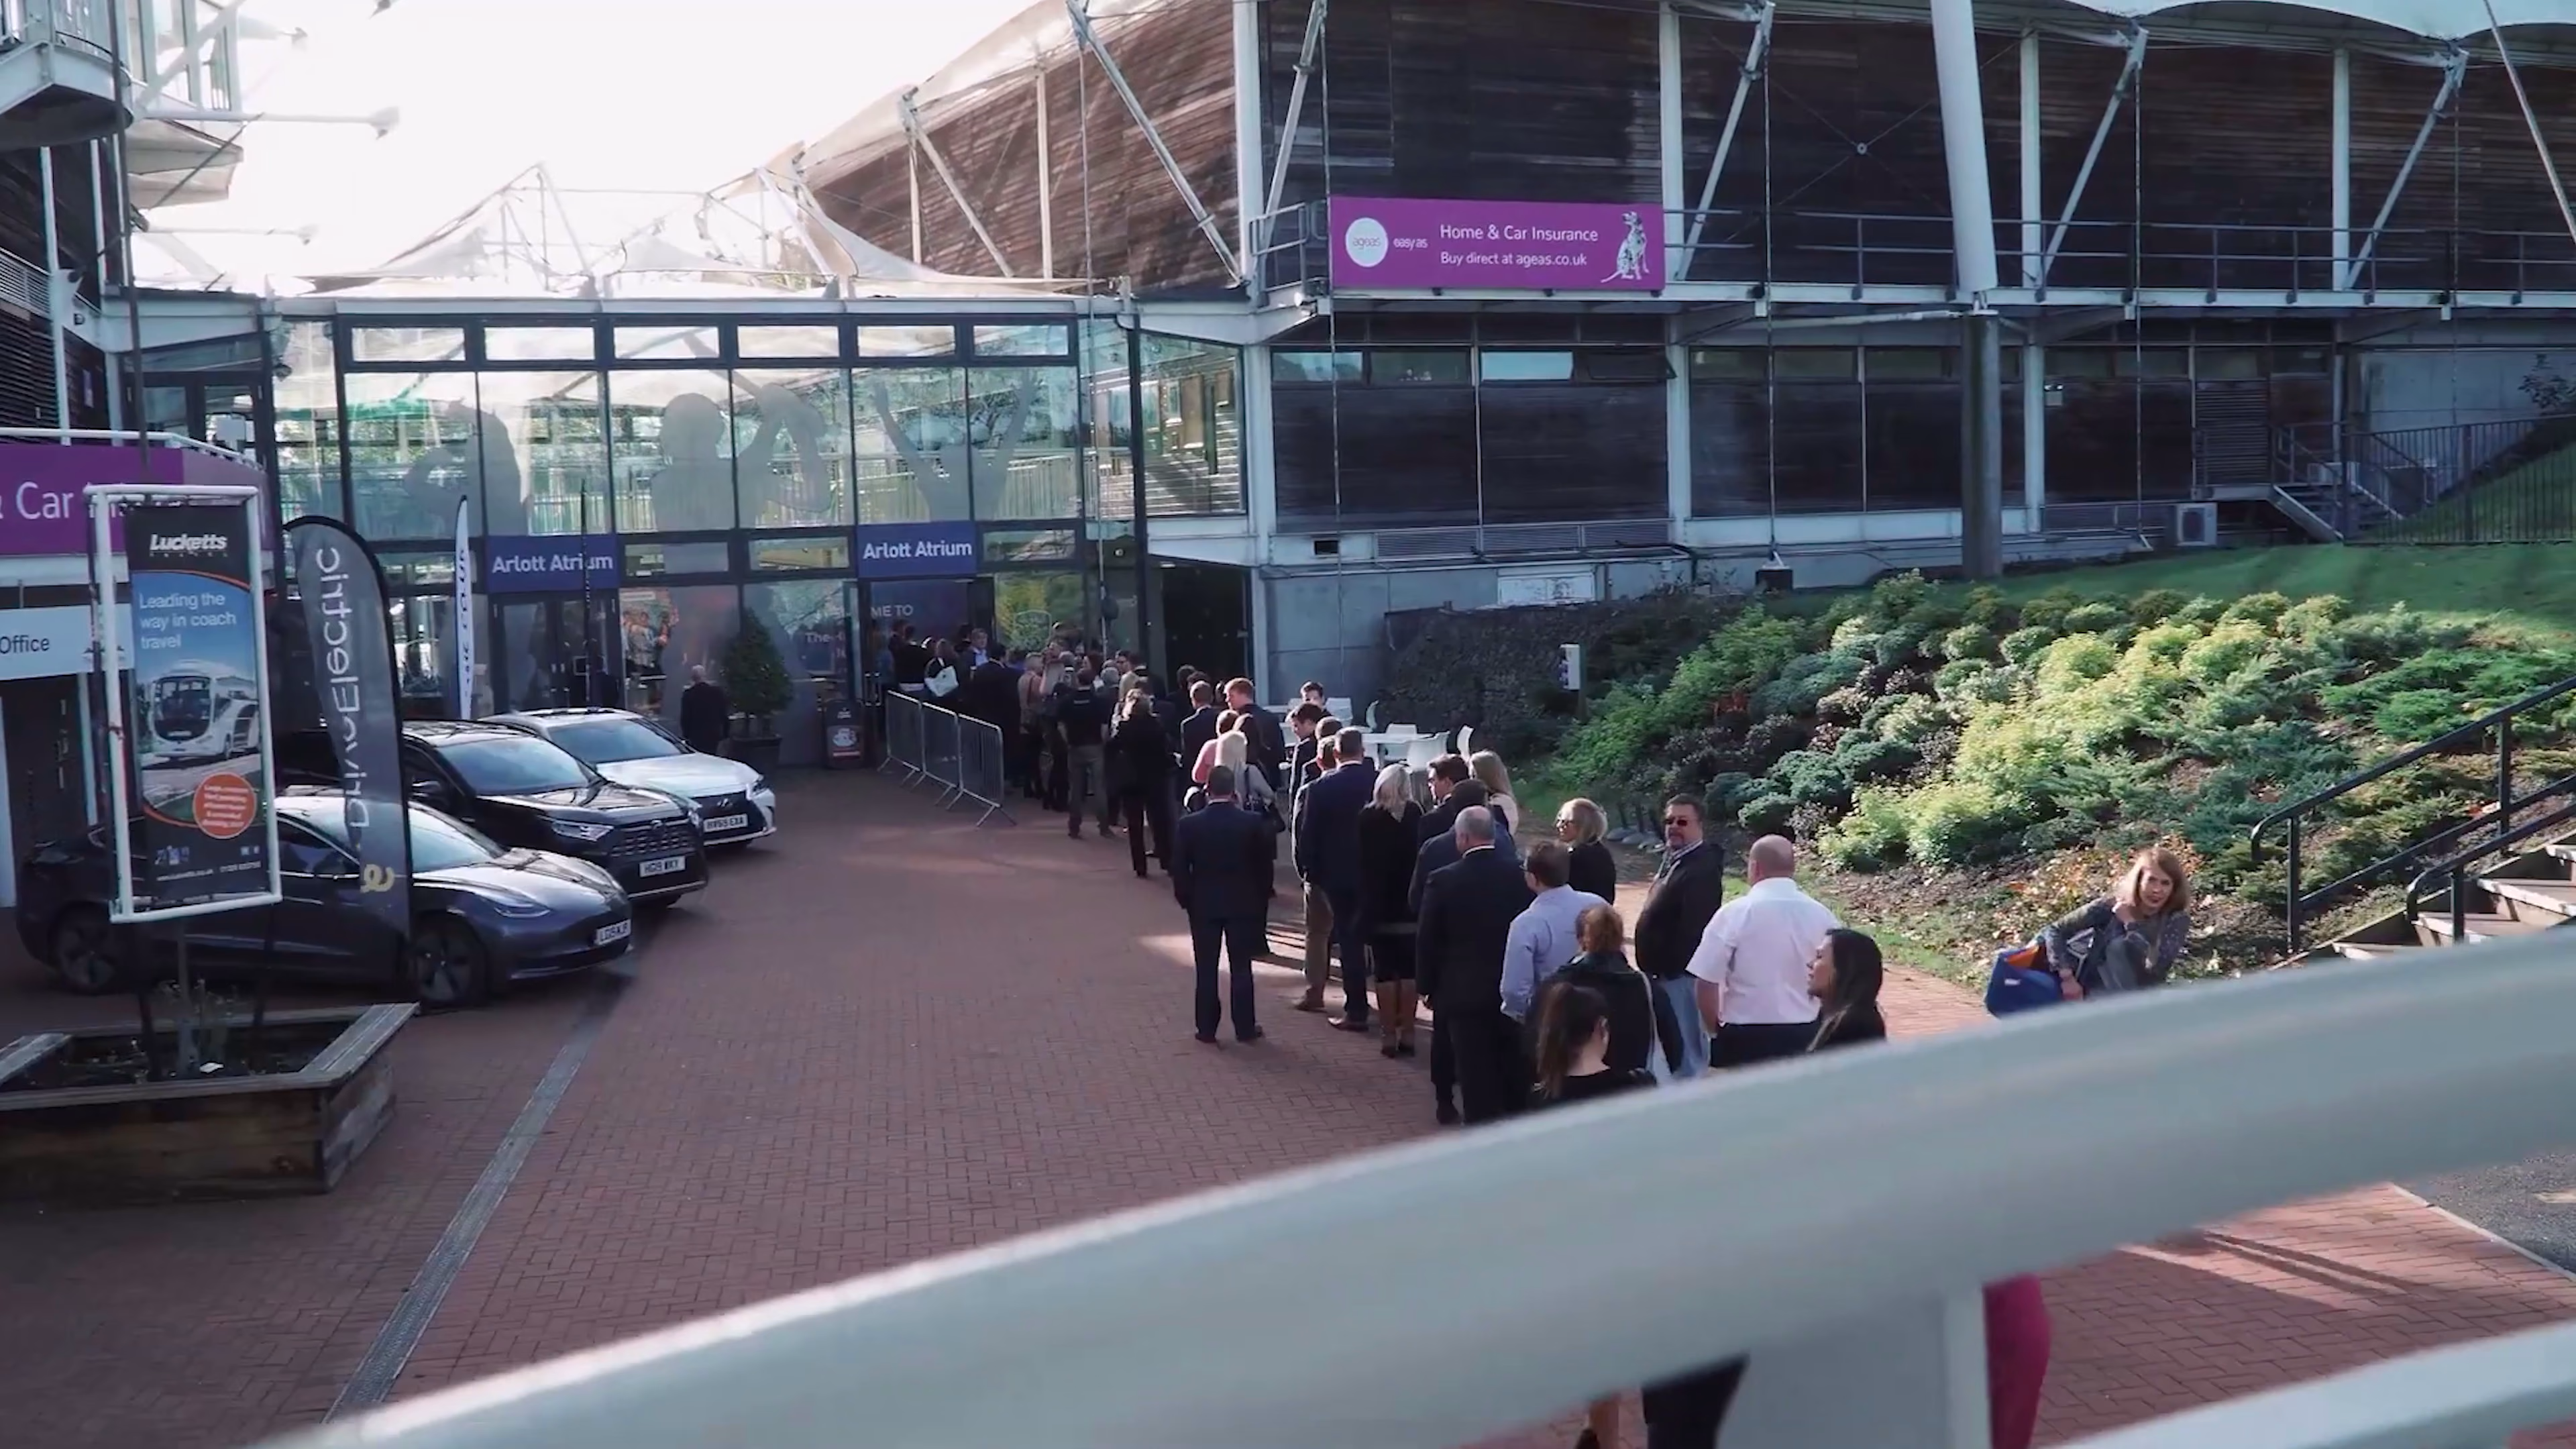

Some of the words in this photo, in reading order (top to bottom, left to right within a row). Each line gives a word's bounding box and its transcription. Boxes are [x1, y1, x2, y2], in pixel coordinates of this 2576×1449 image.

[1440, 224, 1484, 240] Home
[1487, 223, 1500, 240] &
[1504, 225, 1527, 240] Car
[1532, 226, 1599, 242] Insurance
[1352, 237, 1381, 250] ageas
[1440, 251, 1464, 266] Buy
[1466, 252, 1499, 265] direct
[1501, 253, 1513, 265] at
[1515, 253, 1588, 268] ageas.co.uk
[16, 481, 74, 520] Car
[149, 533, 228, 551] Lucketts
[862, 542, 912, 559] Arlott
[914, 540, 973, 558] Atrium
[492, 555, 547, 574] Arlott
[549, 553, 614, 572] Atrium
[139, 593, 199, 610] Leading
[201, 592, 226, 607] the
[140, 616, 168, 633] way
[172, 613, 187, 627] in
[190, 611, 237, 627] coach
[0, 634, 50, 655] Office
[140, 634, 182, 649] travel
